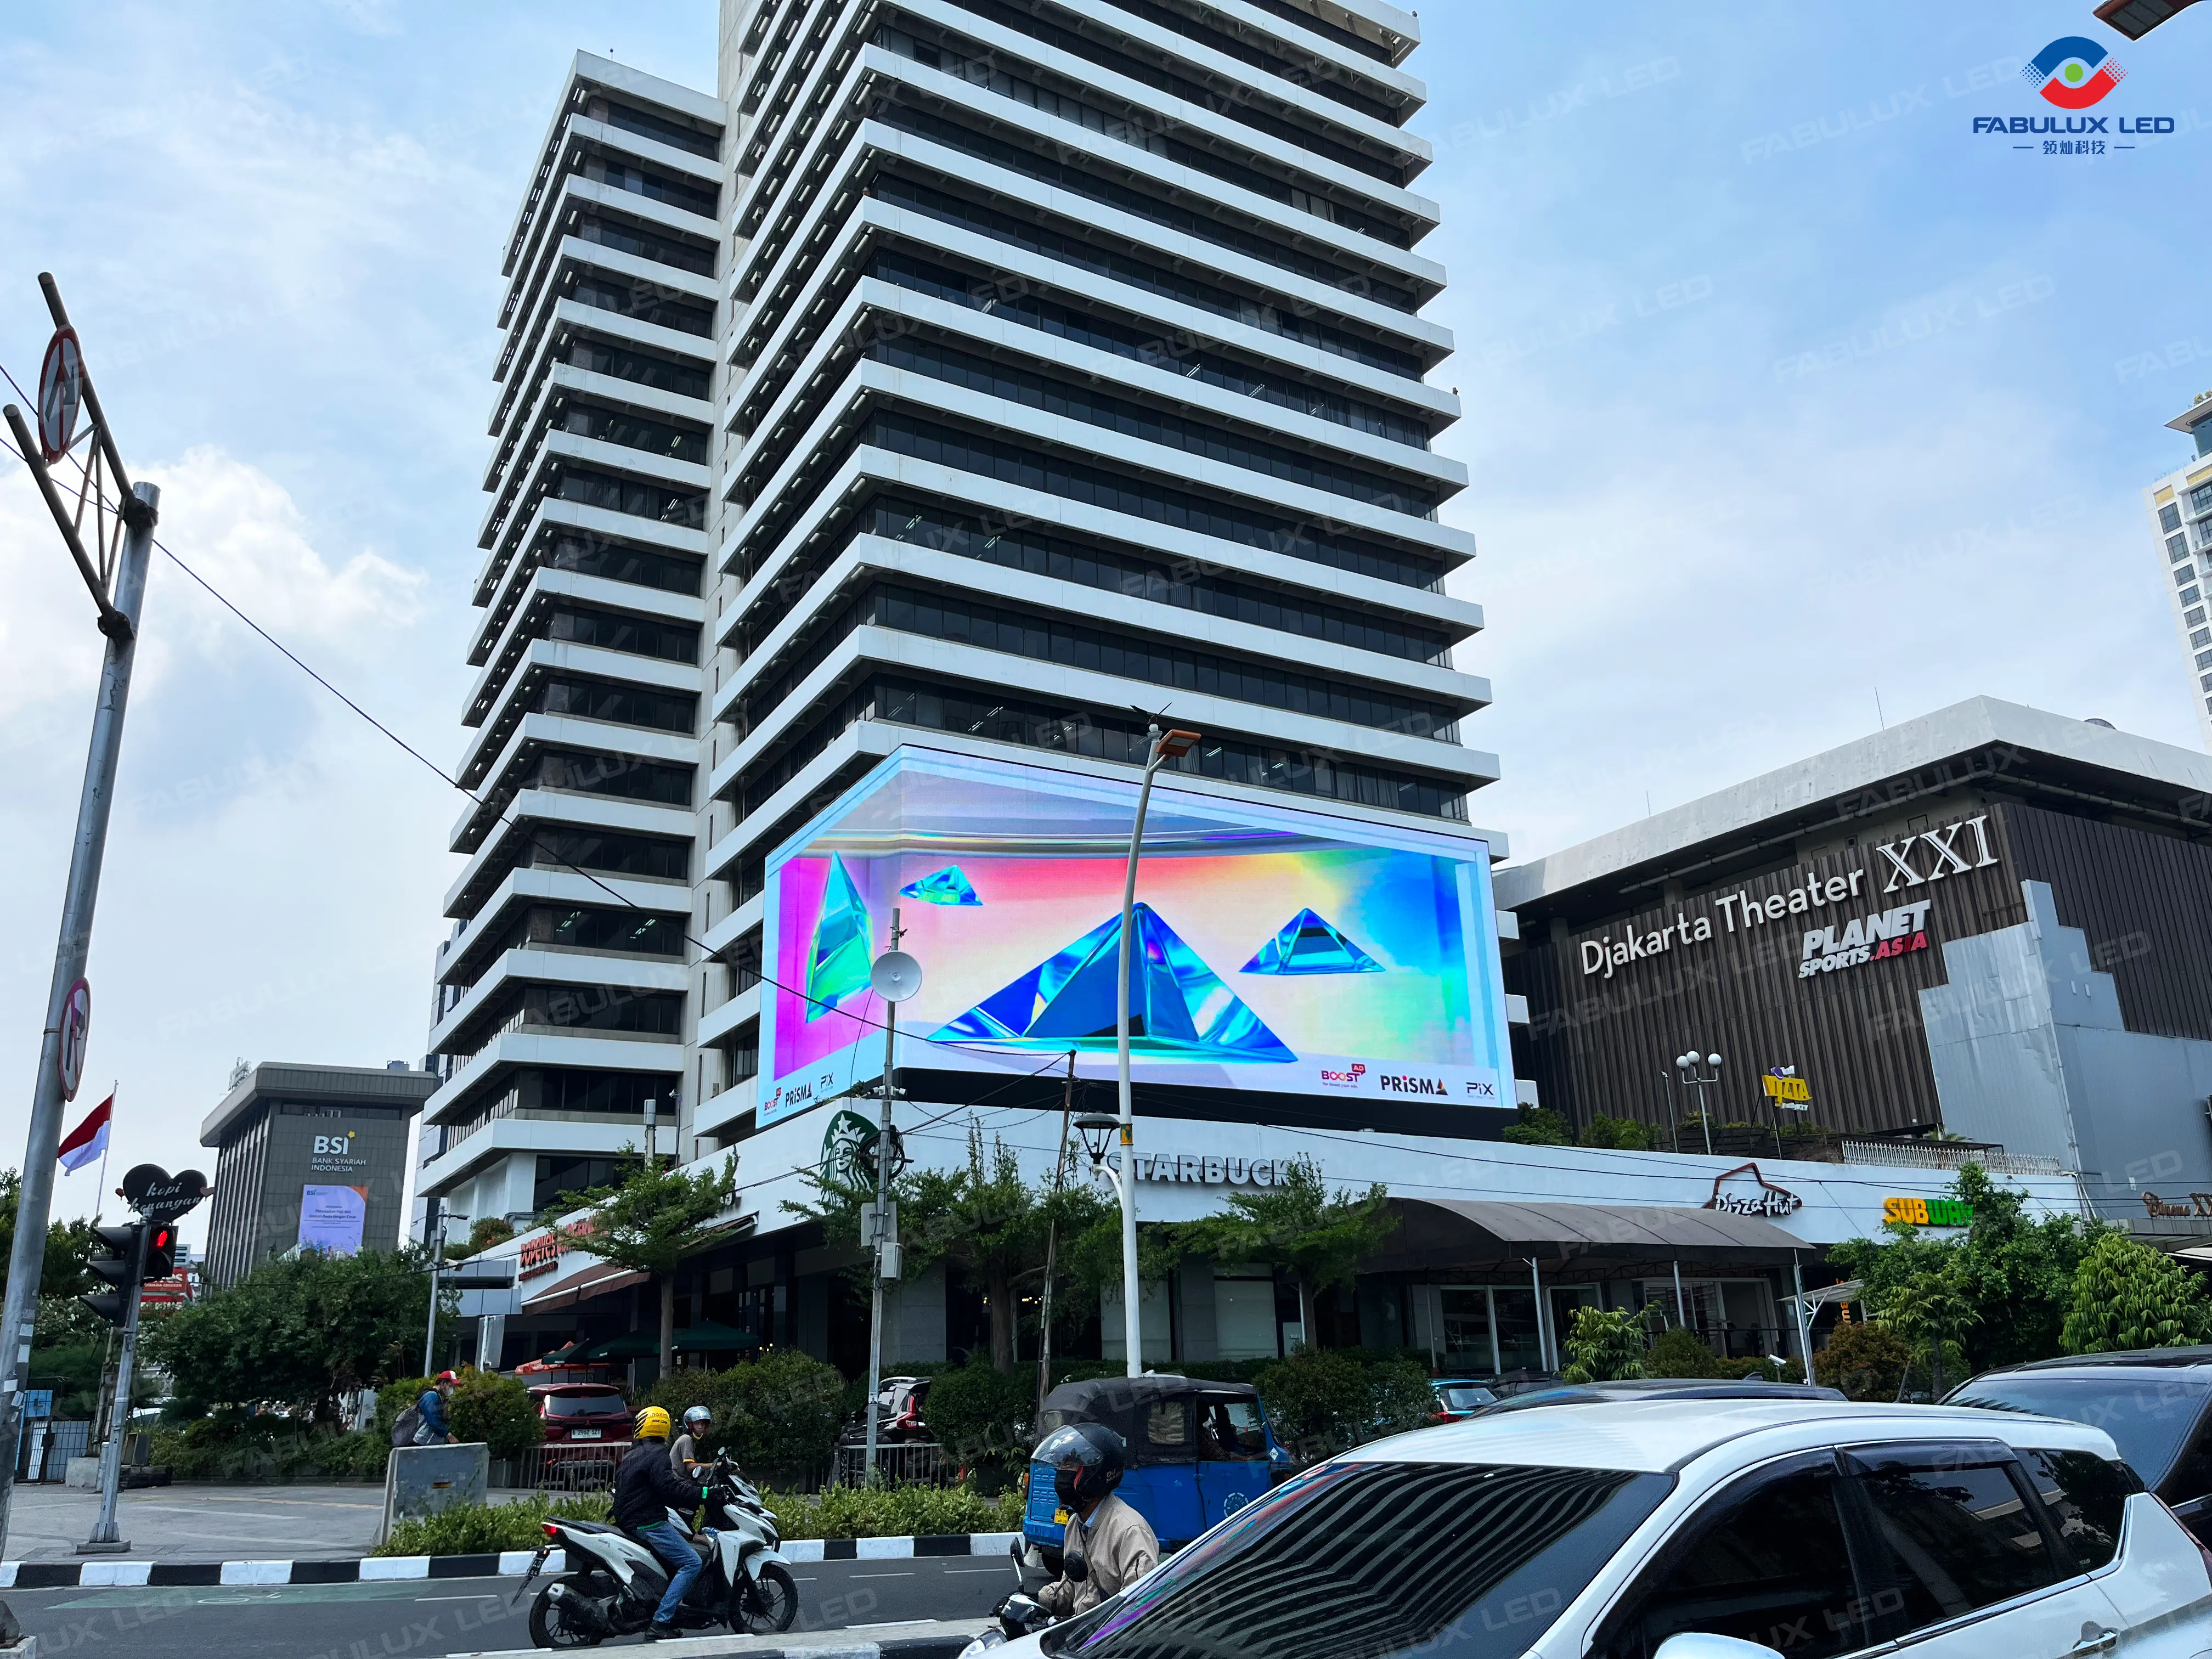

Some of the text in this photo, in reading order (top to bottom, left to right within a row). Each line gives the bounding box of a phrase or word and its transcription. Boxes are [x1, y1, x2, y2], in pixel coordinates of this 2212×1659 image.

[1581, 815, 1999, 979] Djakarta Theater XXI
[1802, 899, 1932, 961] PLANET
[1321, 1070, 1361, 1082] BOOST
[313, 1135, 349, 1155] BSI
[311, 1164, 353, 1172] INDONESIA
[335, 1158, 366, 1166] SYARIAH
[146, 1181, 183, 1197] kopi
[1715, 1189, 1799, 1218] Pizza Hut
